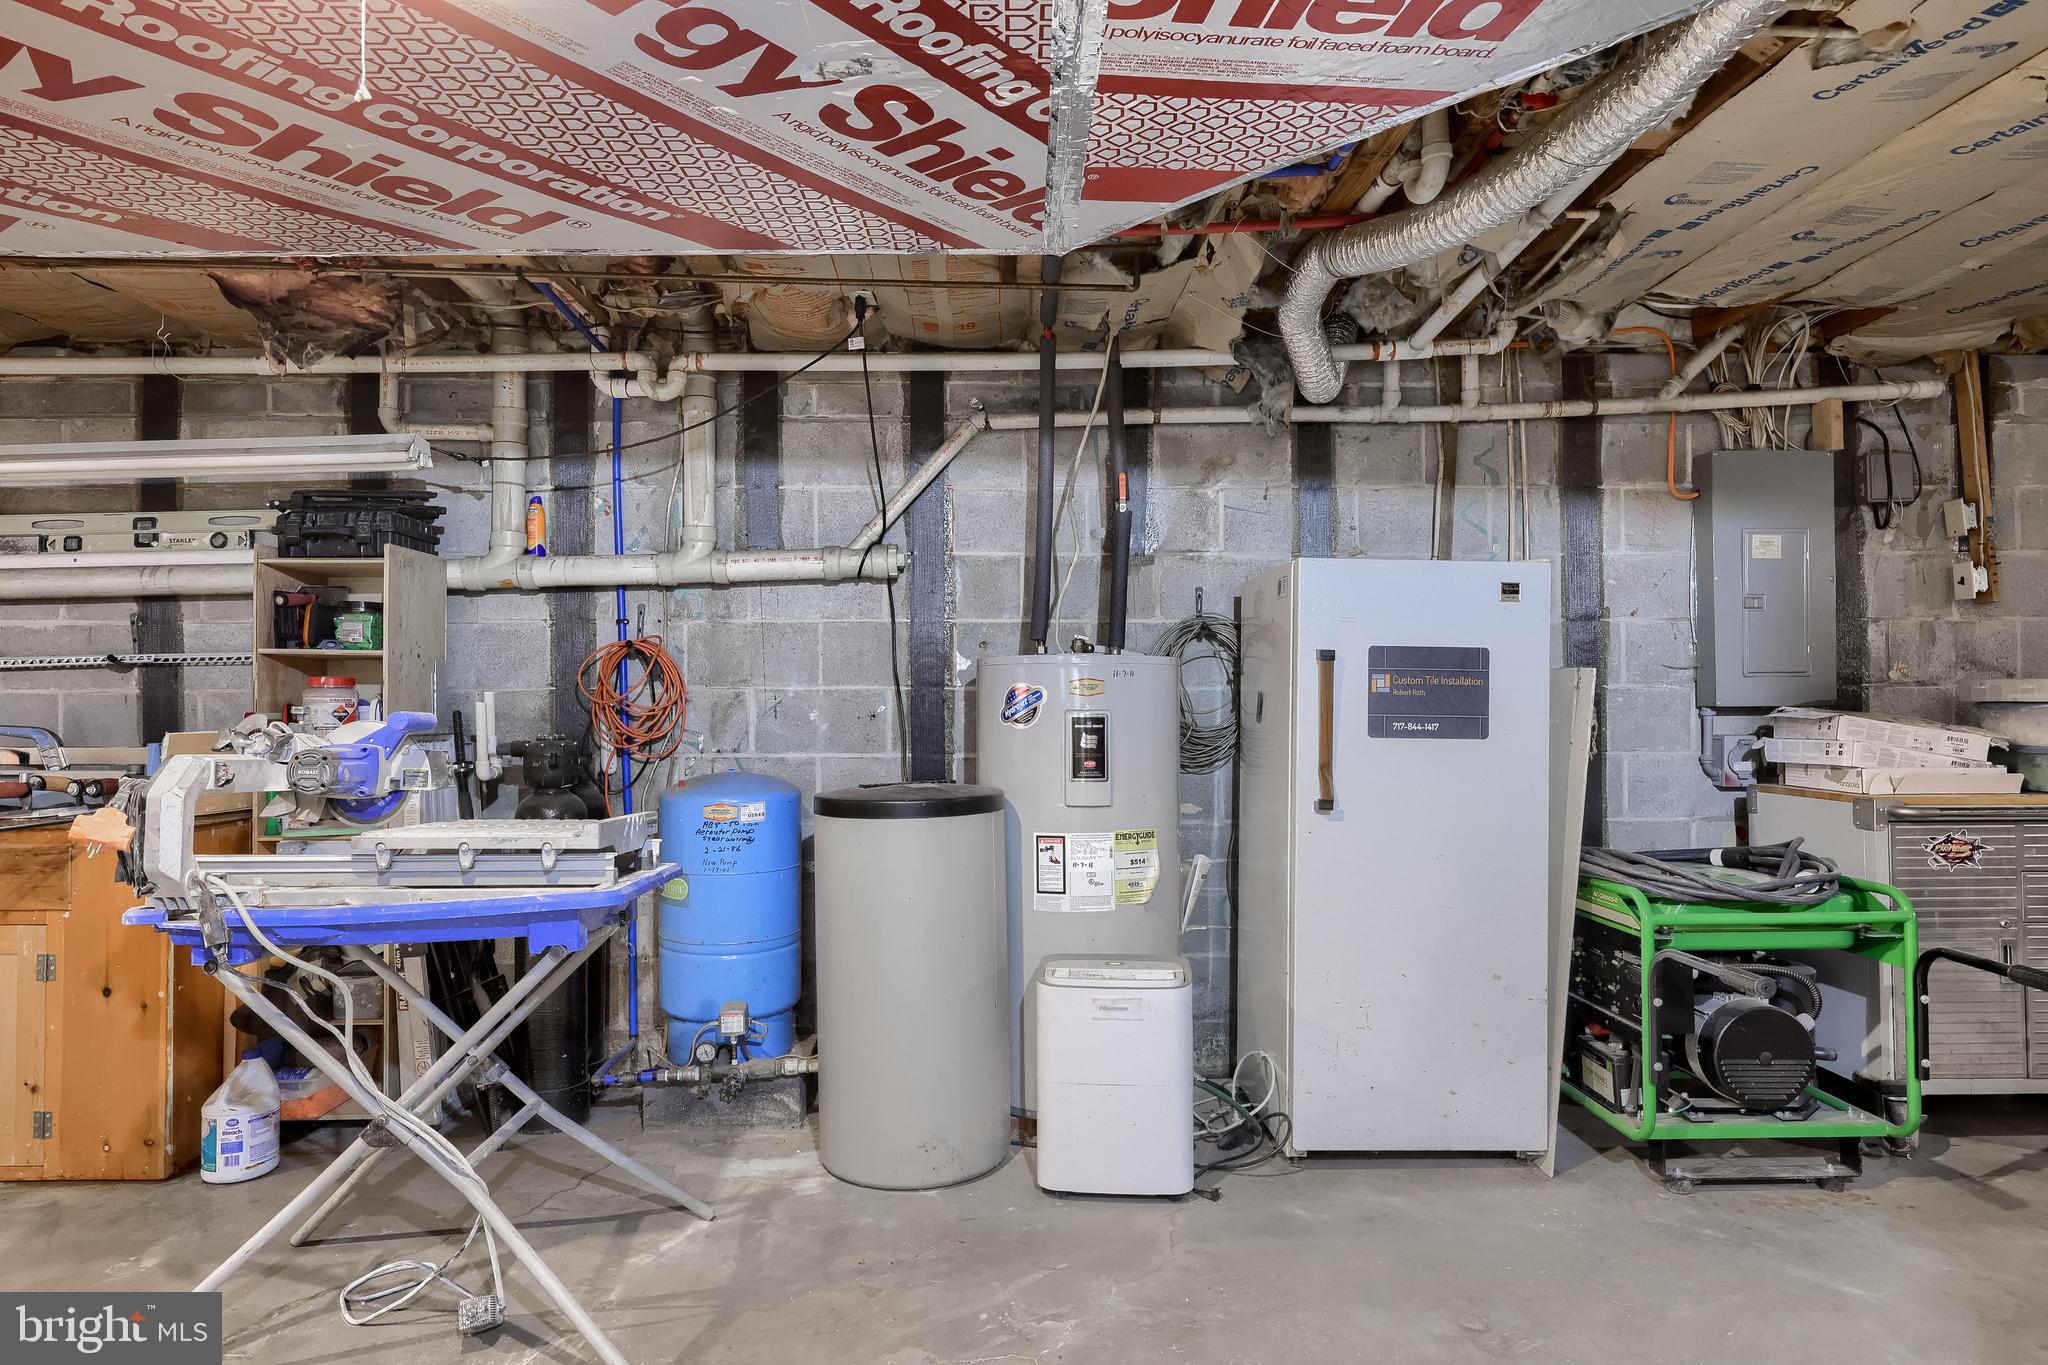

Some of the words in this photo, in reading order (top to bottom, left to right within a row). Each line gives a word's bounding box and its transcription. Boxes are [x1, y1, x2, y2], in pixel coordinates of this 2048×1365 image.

[1108, 25, 1285, 49] polyisocyanurate
[1286, 34, 1321, 50] foil
[1315, 38, 1379, 53] faced
[1376, 40, 1434, 56] foam
[135, 124, 185, 143] rigid
[787, 118, 823, 143] rigid
[816, 126, 930, 191] polyisocyanurate
[152, 92, 569, 235] Shield
[361, 102, 673, 221] Corporation
[0, 186, 122, 224] tion
[1699, 266, 1776, 303] tainTeed
[168, 536, 198, 547] STANLEY
[1392, 675, 1424, 685] Custom
[1425, 675, 1440, 685] Tile
[1440, 675, 1484, 686] Installation
[1392, 688, 1412, 696] Robert
[1412, 688, 1426, 696] Roth
[1392, 722, 1440, 731] 717-844-1417
[702, 858, 717, 867] New
[719, 857, 738, 869] Pump
[1129, 858, 1147, 866] $514
[1099, 1004, 1129, 1012] Hisense
[221, 1129, 243, 1137] Bleach
